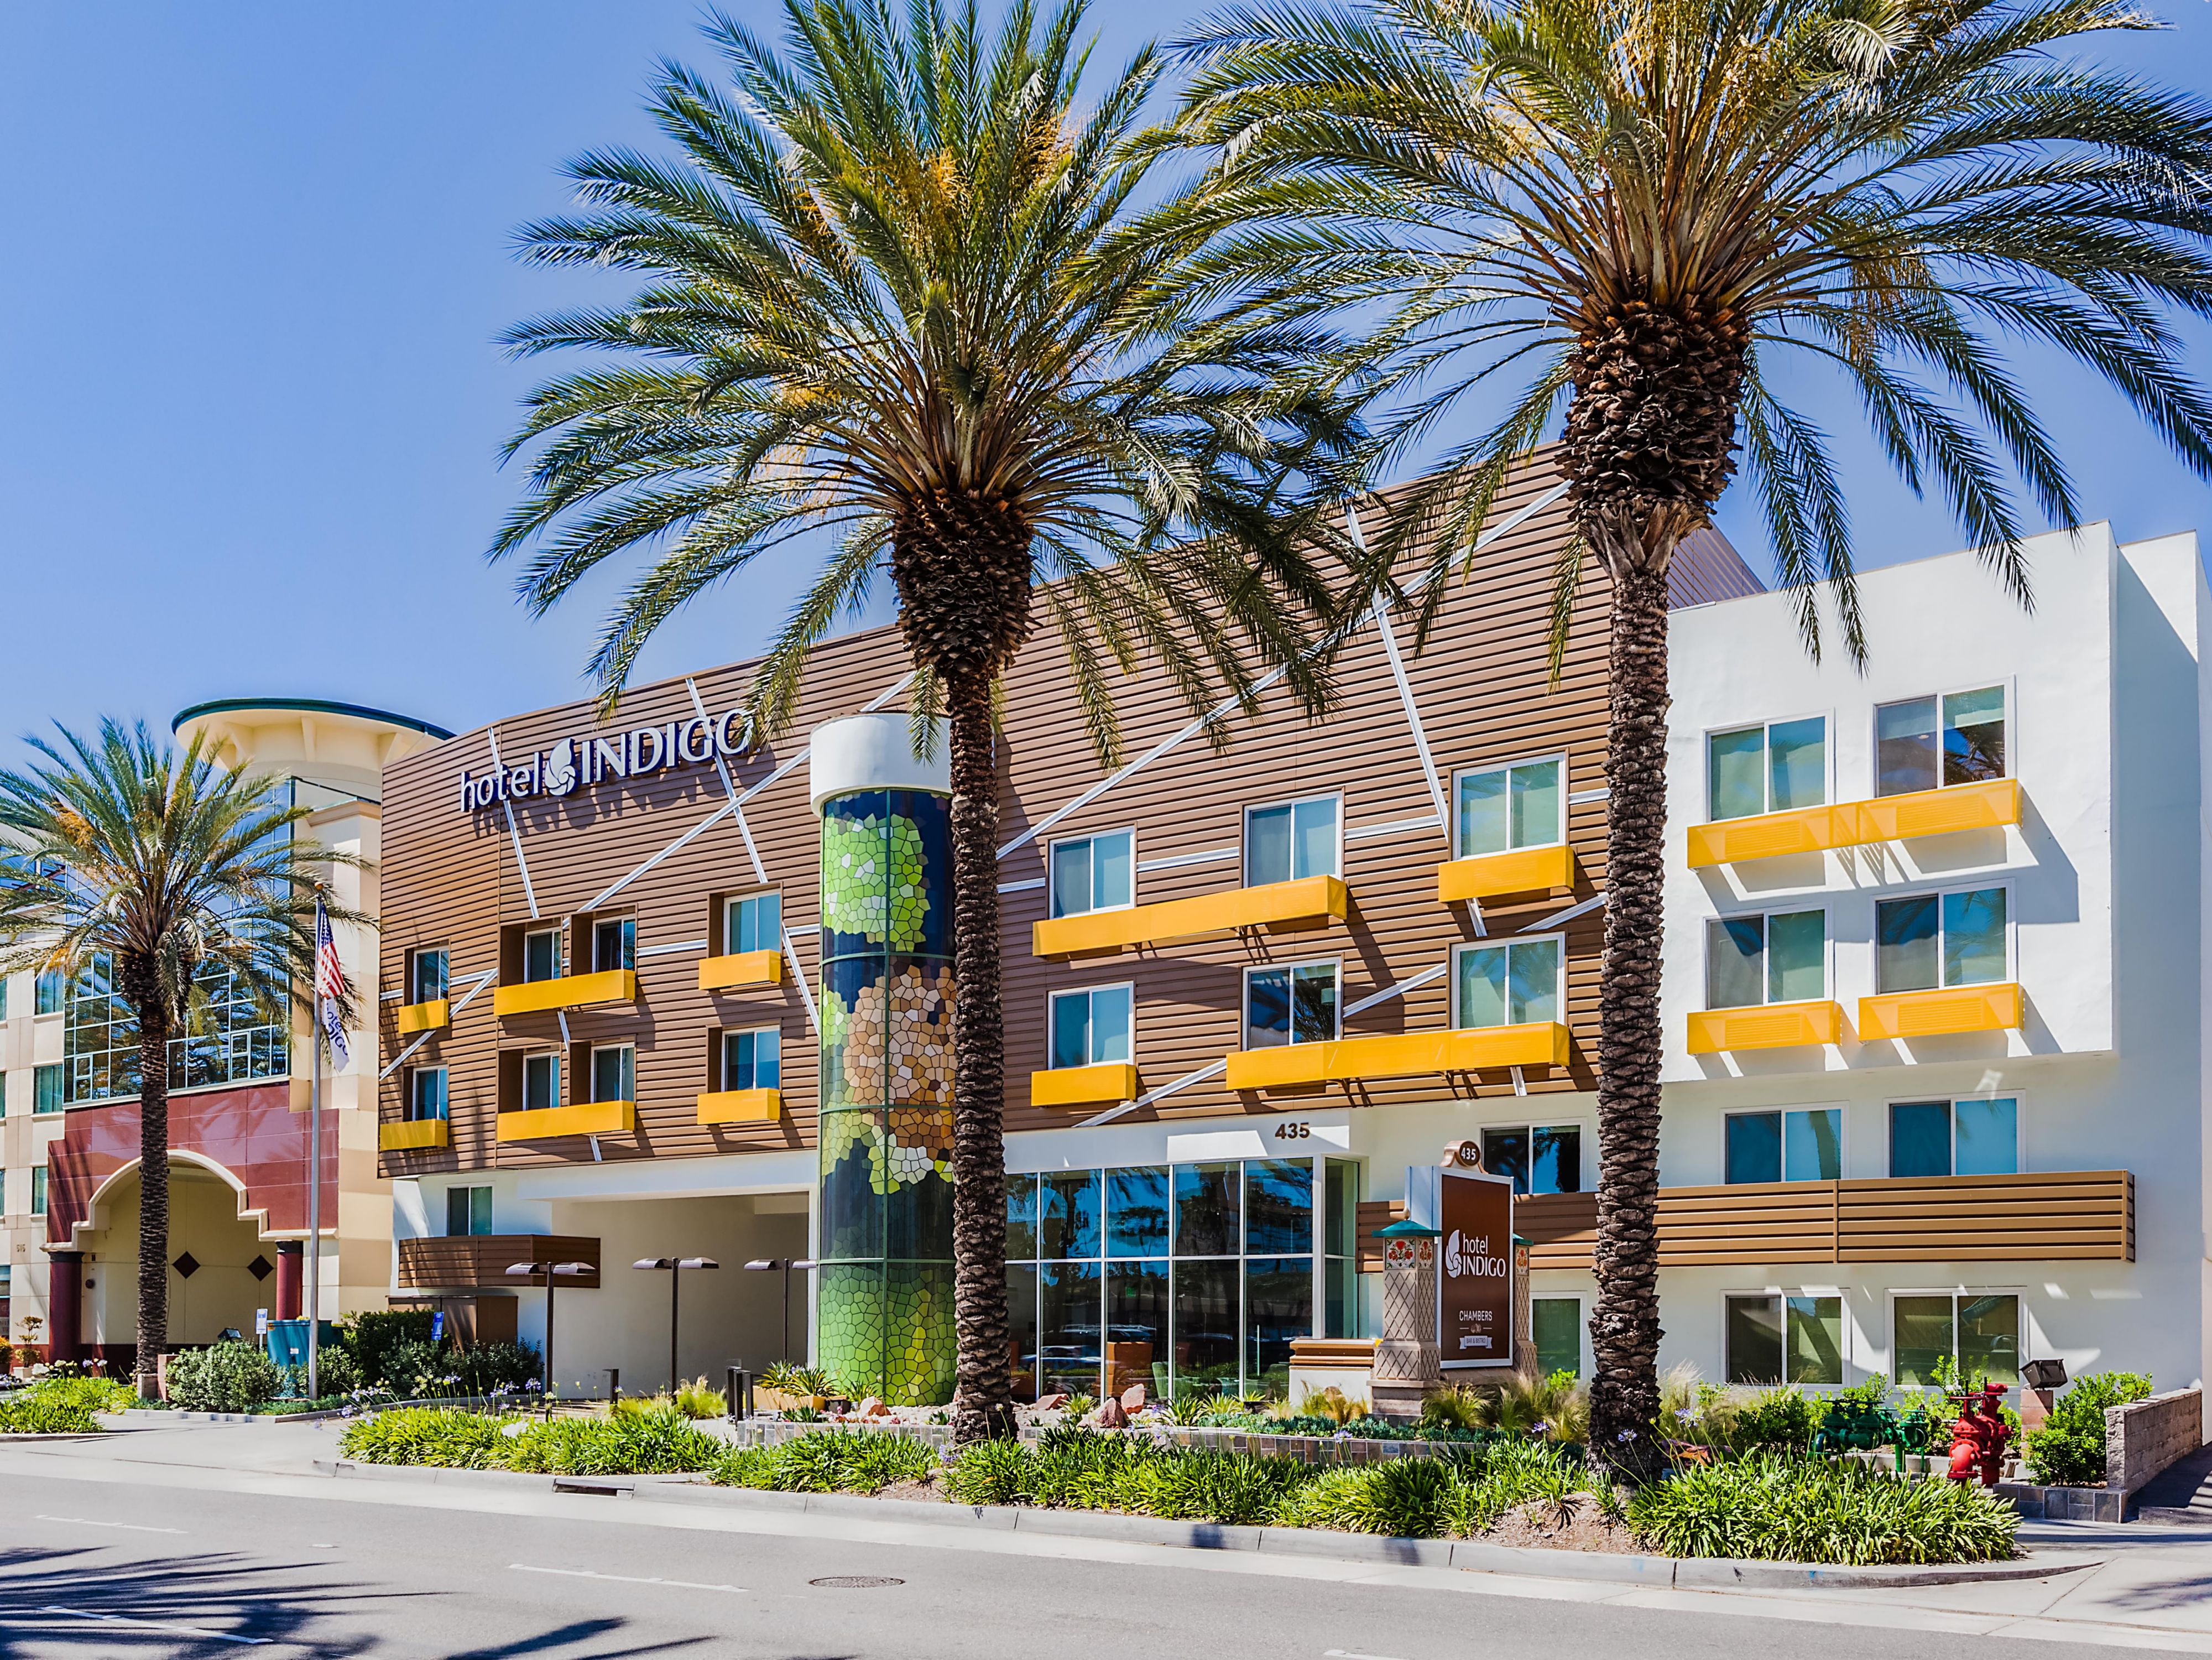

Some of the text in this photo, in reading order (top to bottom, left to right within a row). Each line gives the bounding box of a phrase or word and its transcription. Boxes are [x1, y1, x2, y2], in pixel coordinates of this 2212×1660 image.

[460, 708, 754, 812] hotel INDIGO
[1275, 1122, 1310, 1139] 435
[1461, 1147, 1476, 1161] 435
[17, 1244, 25, 1252] 515
[1463, 1233, 1488, 1255] hotel
[1463, 1255, 1506, 1277] INDIGO
[1459, 1310, 1493, 1321] CHAMBERS
